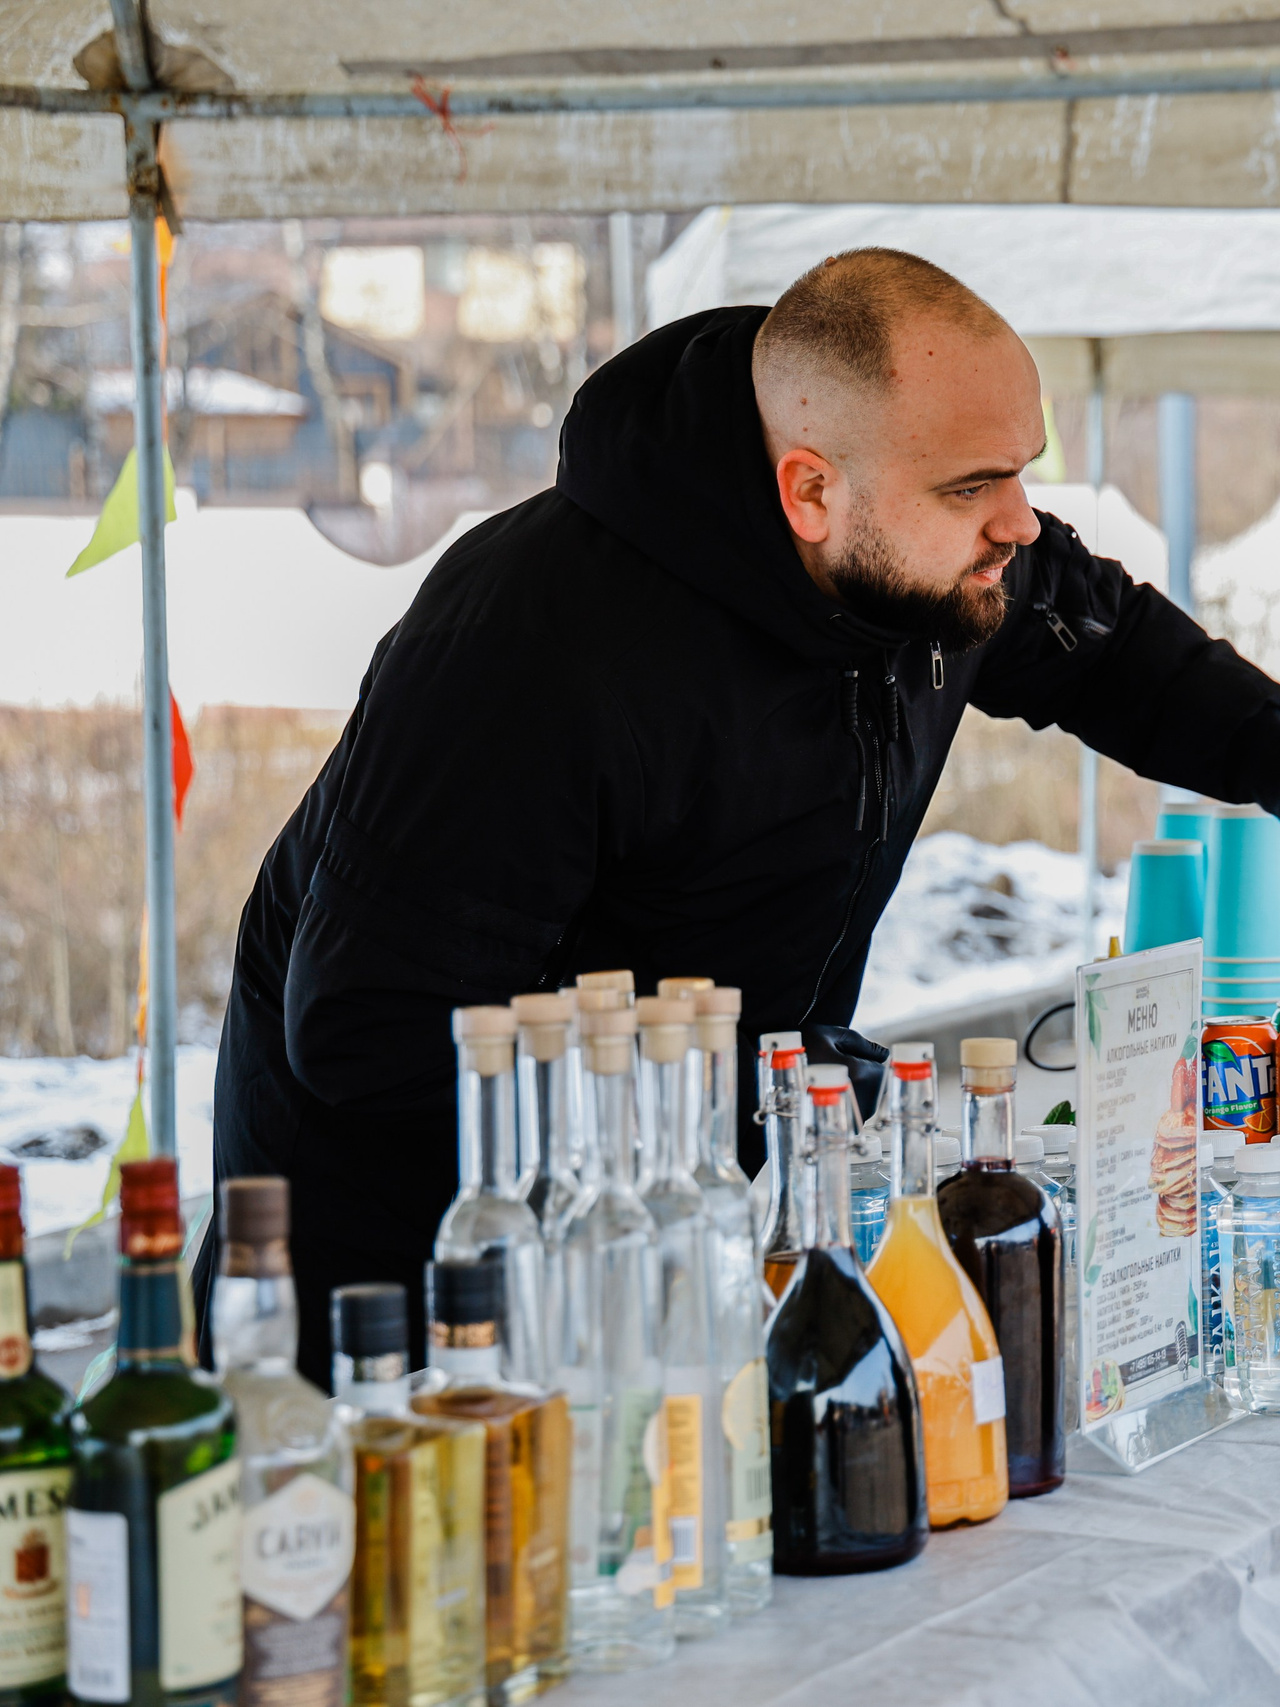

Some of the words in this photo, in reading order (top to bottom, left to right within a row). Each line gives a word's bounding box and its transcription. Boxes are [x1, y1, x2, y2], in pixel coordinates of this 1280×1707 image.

[1127, 1003, 1158, 1034] МЕНЮ
[1106, 1040, 1149, 1063] АЛКОГОЛЬНЫЕ
[1150, 1033, 1177, 1052] НАПИТКИ
[1204, 1105, 1230, 1115] Orange
[1230, 1101, 1258, 1112] Flavor
[1102, 1256, 1154, 1289] БЕЗАЛКОГОЛЬНЫЕ
[1154, 1246, 1181, 1269] НАПИТКИ
